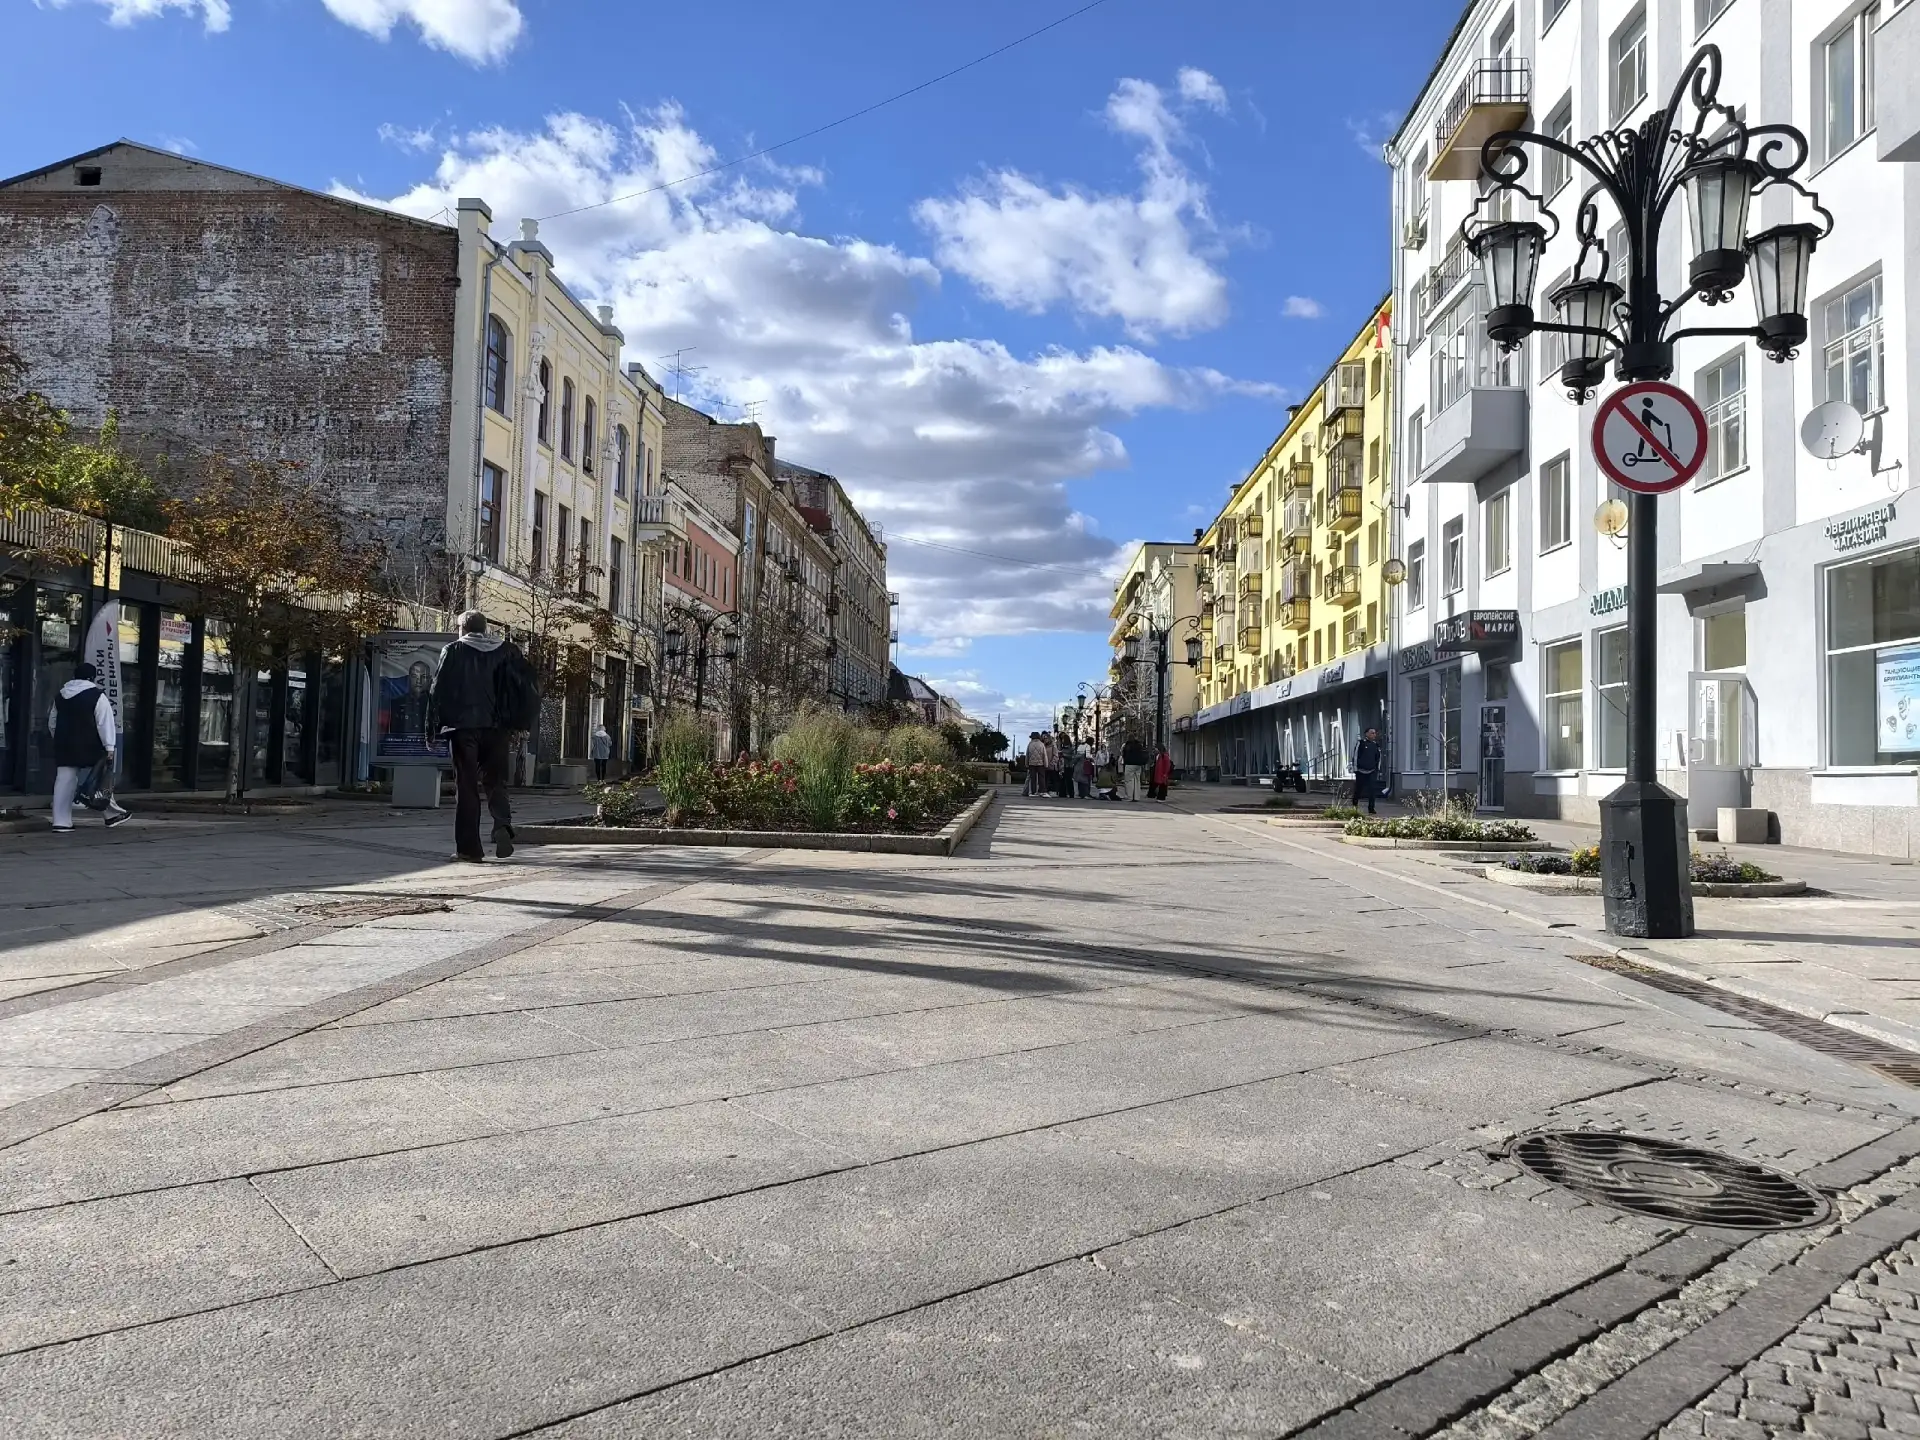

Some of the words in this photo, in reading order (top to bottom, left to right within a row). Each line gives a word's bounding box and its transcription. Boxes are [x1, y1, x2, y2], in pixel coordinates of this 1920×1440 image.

[1823, 504, 1895, 538] ЮВЕЛИРНЫЙ
[1833, 526, 1885, 551] МАГАЗИН
[1590, 586, 1628, 614] АДАМ
[1473, 610, 1514, 620] ЕВРОПЕЙСКИЕ
[1484, 623, 1515, 633] МАРКИ
[1402, 644, 1431, 669] ОБУВЬ
[97, 649, 106, 694] АРКИ
